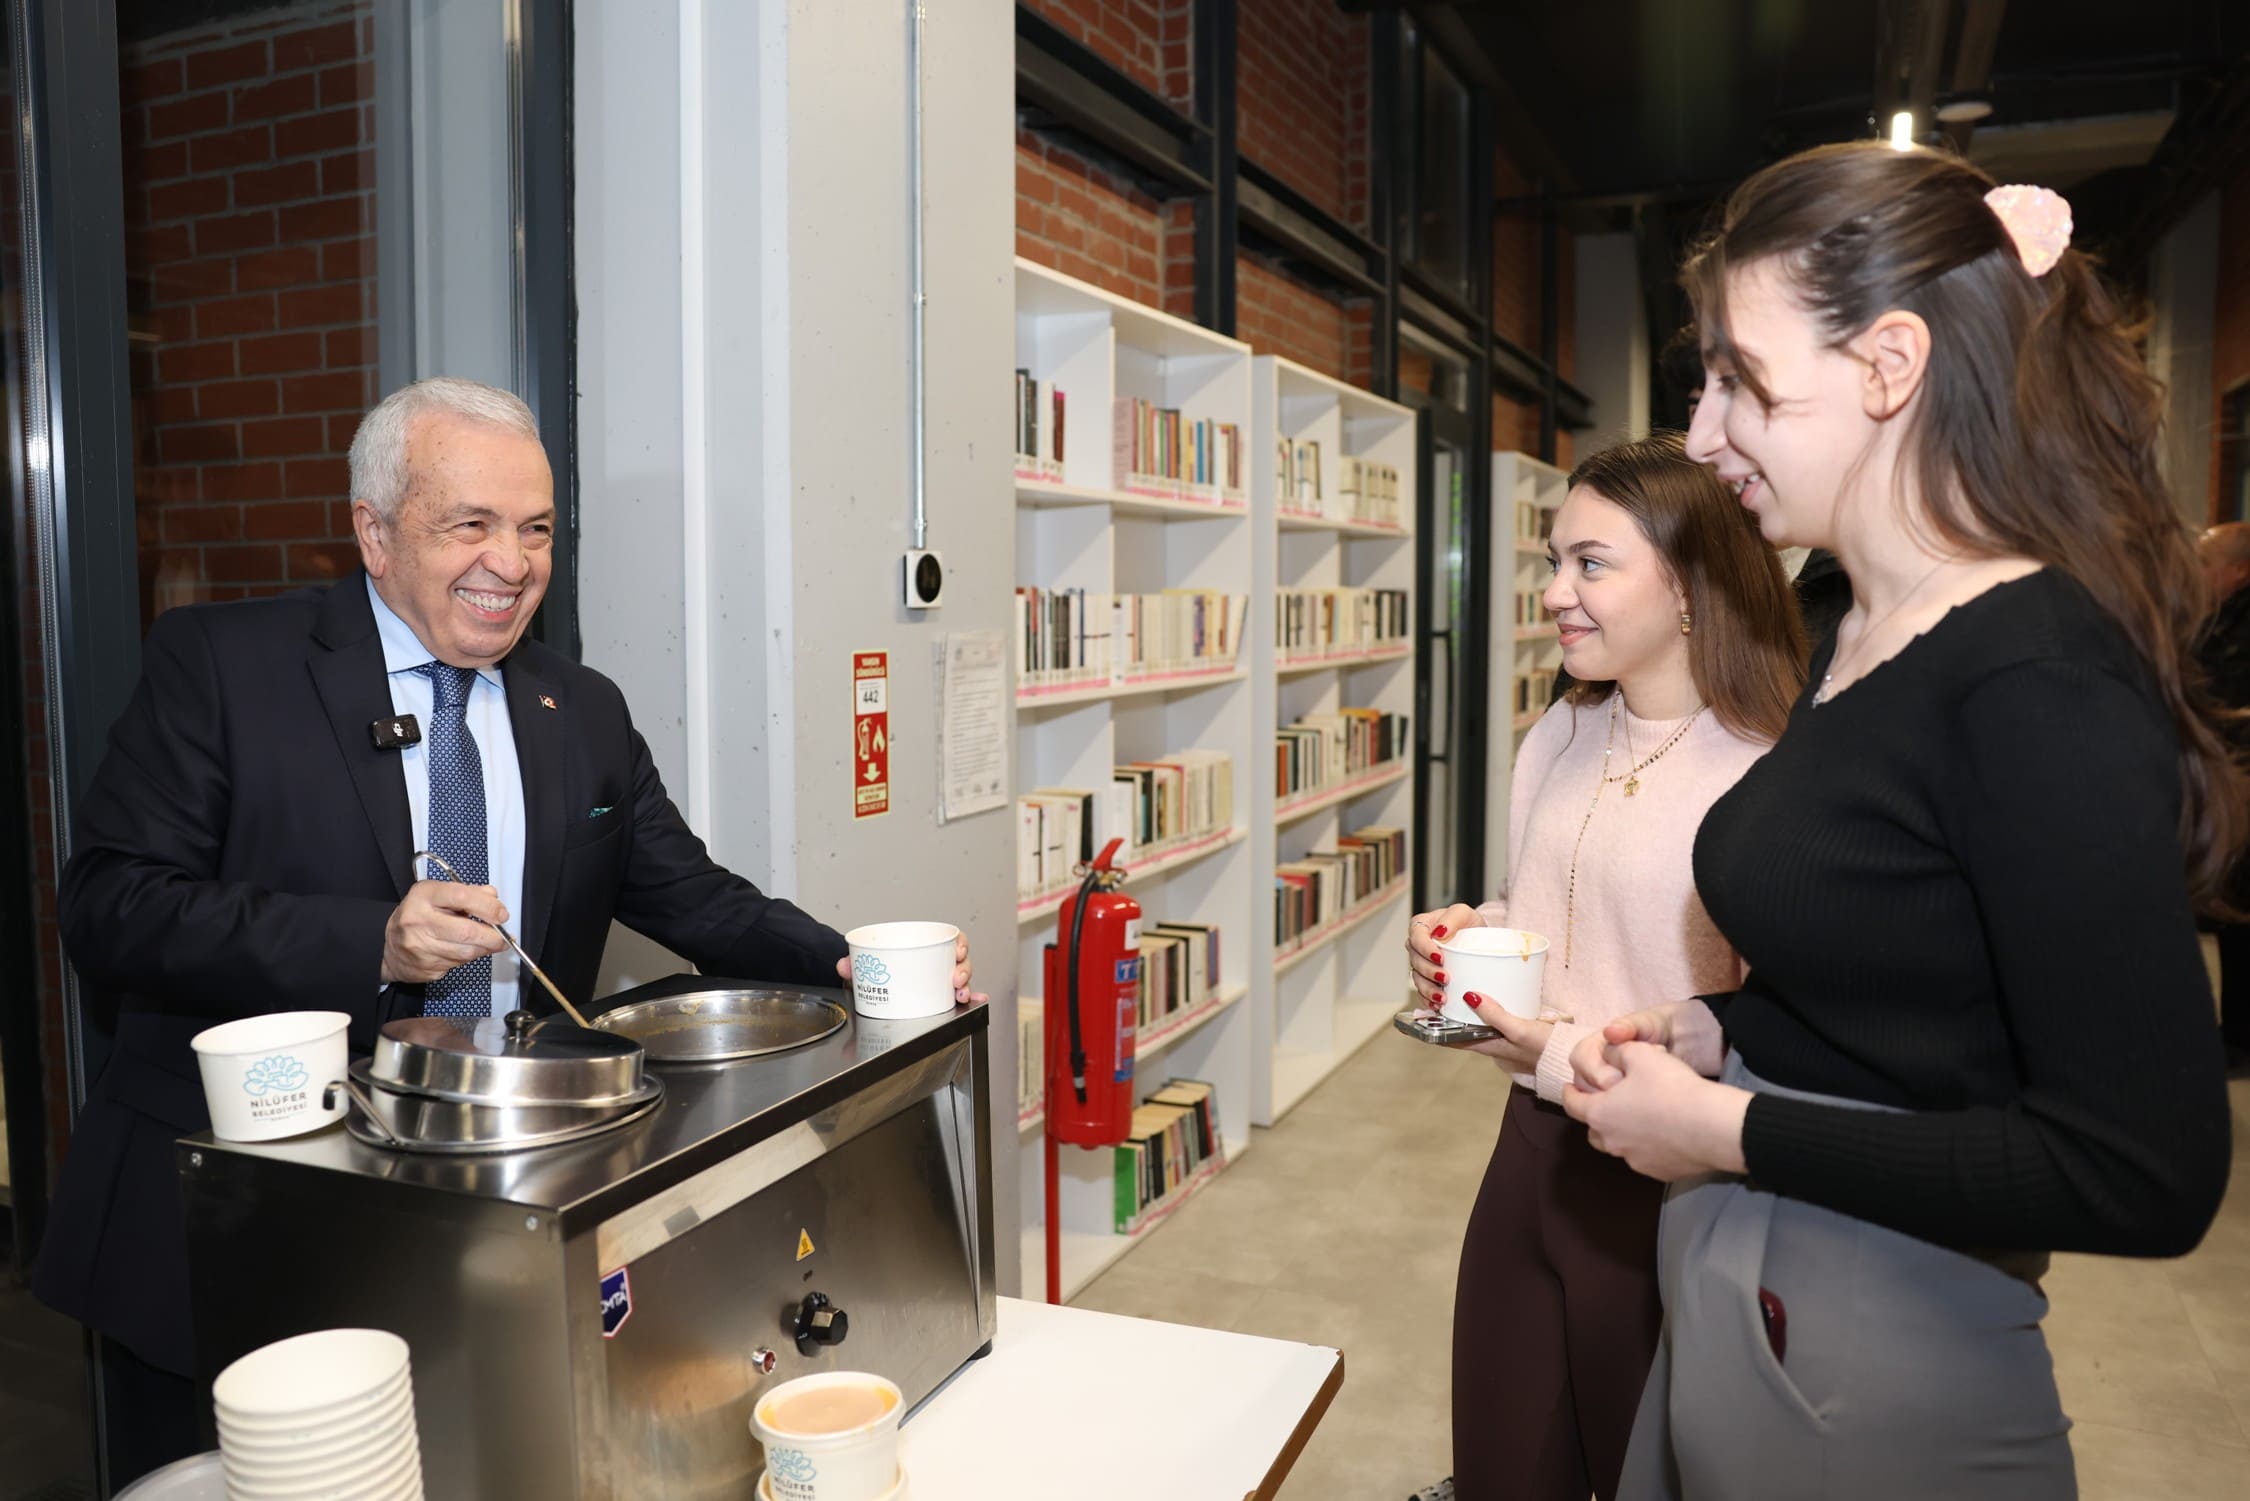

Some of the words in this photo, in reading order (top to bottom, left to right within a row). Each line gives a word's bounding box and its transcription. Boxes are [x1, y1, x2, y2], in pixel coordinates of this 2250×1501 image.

[863, 690, 879, 703] 442
[857, 984, 889, 995] NİLÜFER
[250, 1092, 306, 1108] NİLÜFER
[252, 1102, 308, 1117] BELEDİYESİ
